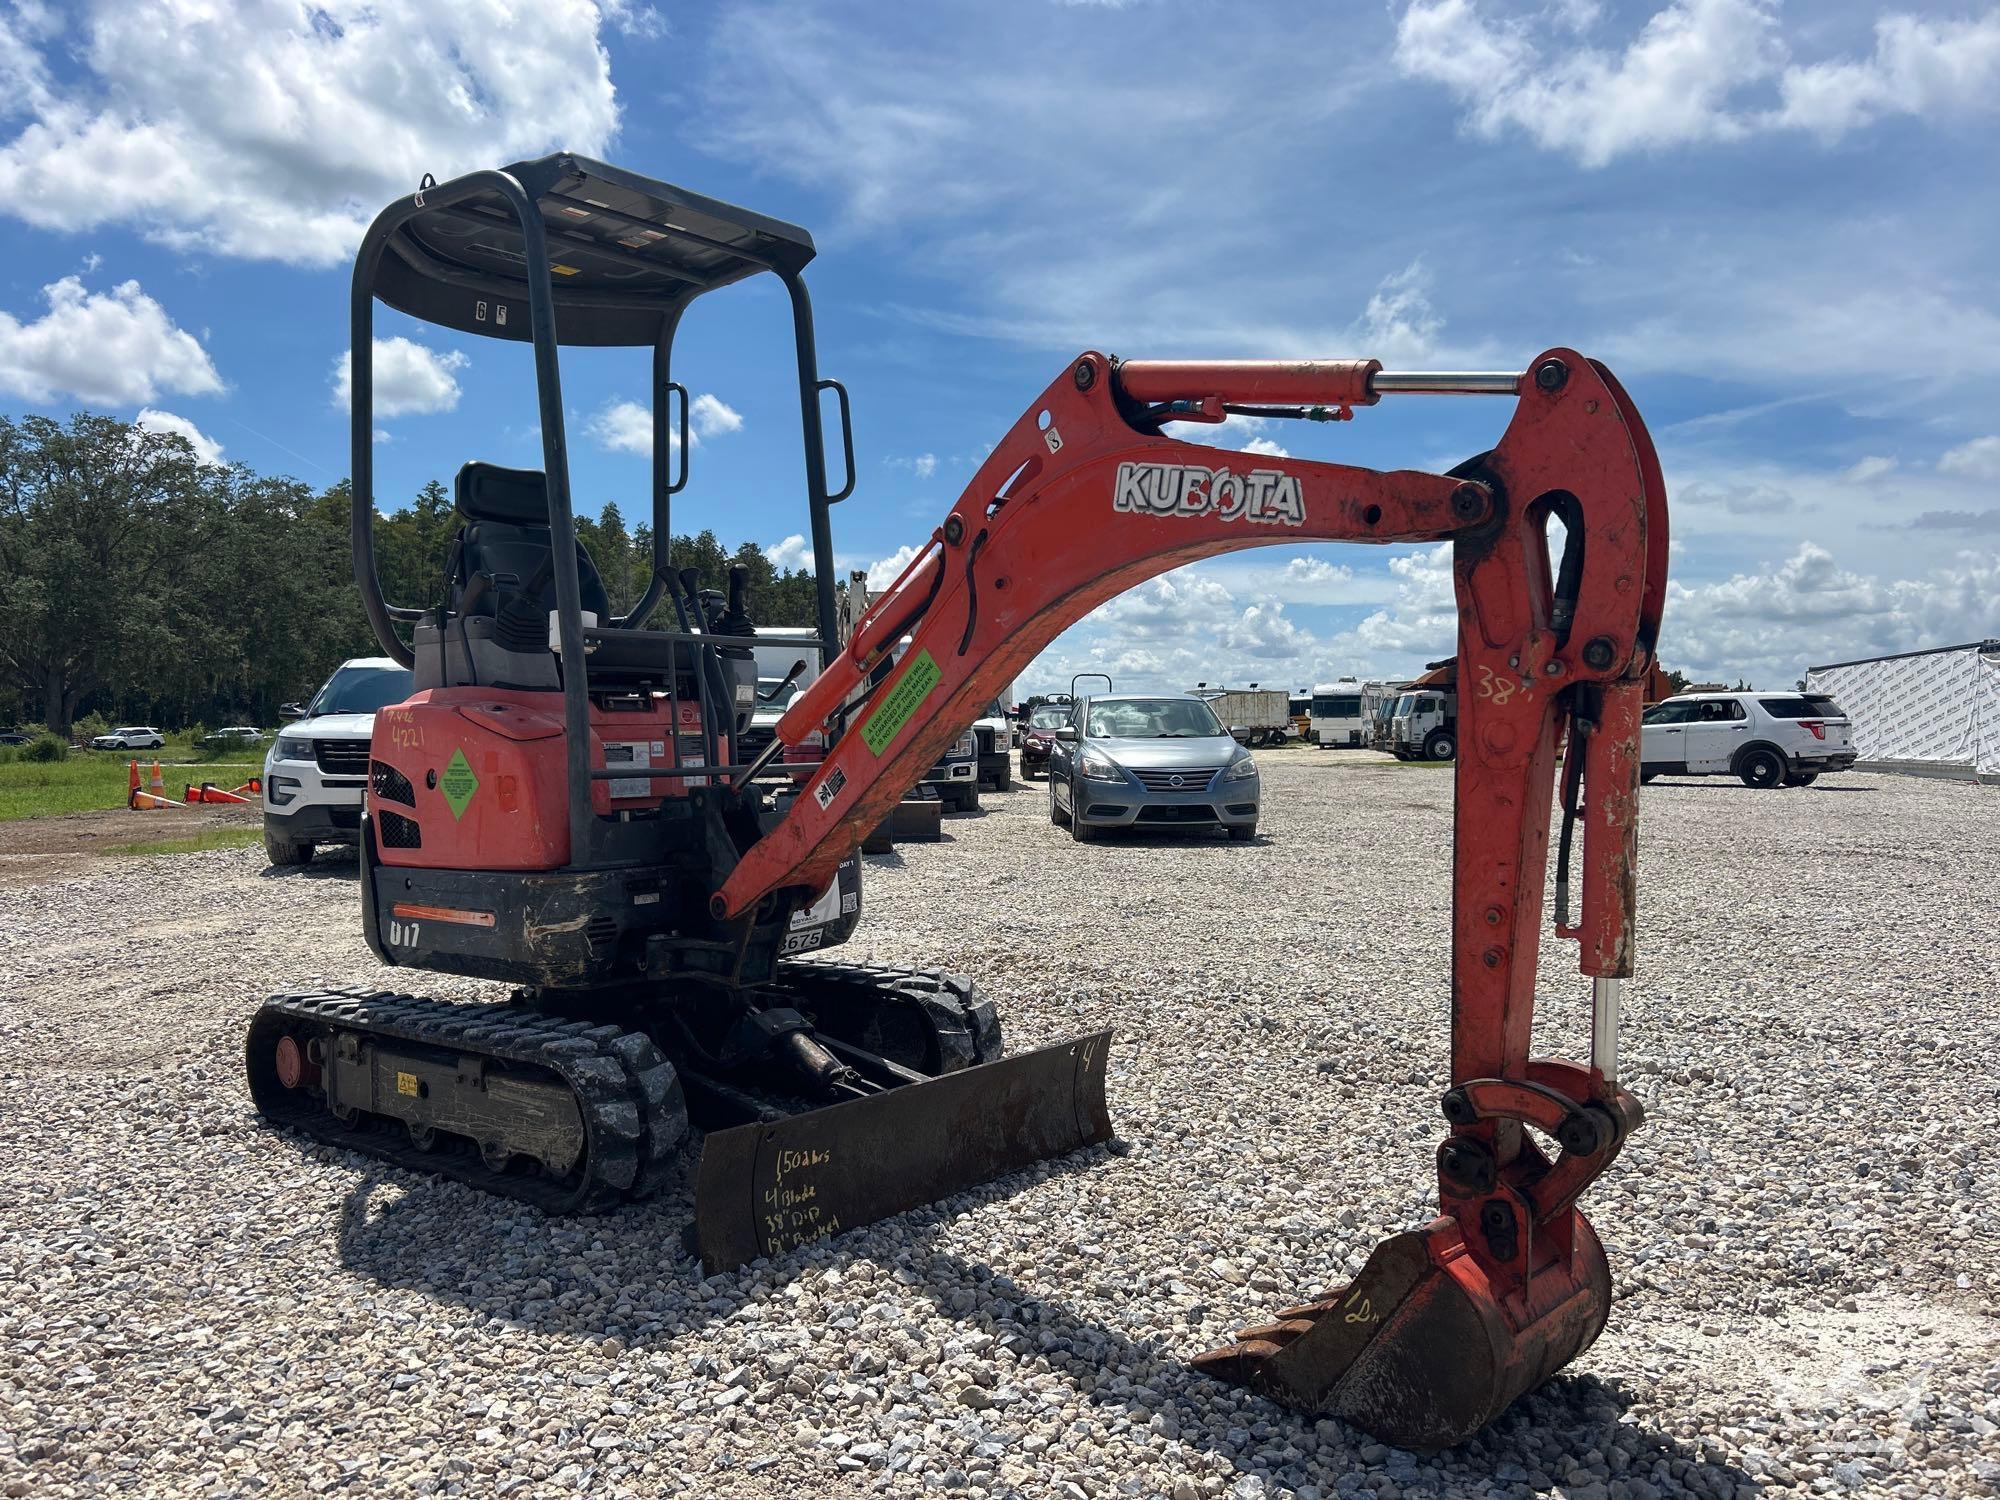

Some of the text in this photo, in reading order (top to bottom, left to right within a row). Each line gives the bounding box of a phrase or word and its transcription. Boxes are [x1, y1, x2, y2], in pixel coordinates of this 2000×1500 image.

[1114, 463, 1306, 525] KUBOTA
[867, 662, 934, 746] BE CHARGED IF THIS MACHINE
[877, 677, 933, 747] IS NOT RETURNED CLEAN
[881, 687, 904, 716] CLEANING
[903, 674, 914, 687] FEE
[912, 661, 926, 676] WILL
[392, 725, 425, 752] 4221
[390, 921, 420, 947] U17
